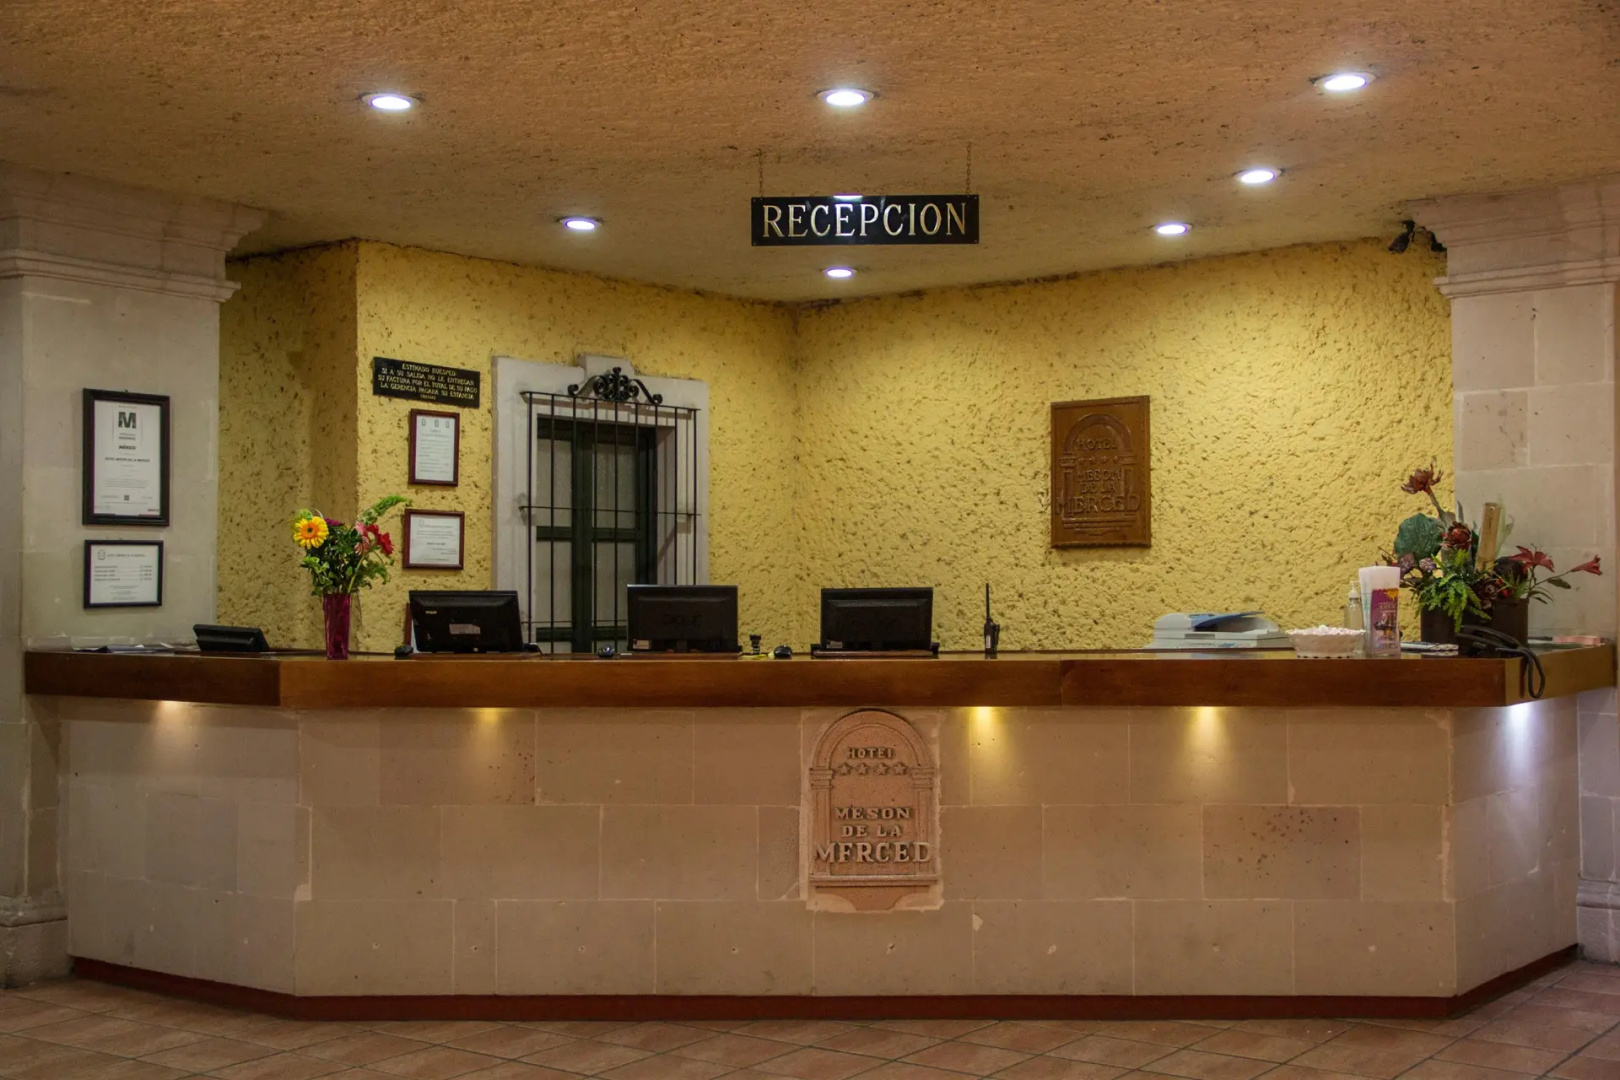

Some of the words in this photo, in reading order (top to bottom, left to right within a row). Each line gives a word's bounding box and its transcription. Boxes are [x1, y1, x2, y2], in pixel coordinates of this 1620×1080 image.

[762, 203, 966, 238] RECEPCION
[402, 363, 430, 373] ESTIMADO
[406, 371, 425, 380] SALIDA
[380, 381, 388, 389] LA
[390, 383, 416, 392] GERENCIA
[449, 390, 475, 399] ESTANCIA
[386, 375, 411, 385] FACTURA
[431, 381, 448, 390] TOTAL
[464, 386, 478, 394] PAGO
[118, 411, 136, 429] M
[1077, 439, 1118, 450] HOTEL
[1080, 482, 1097, 494] DE
[1055, 495, 1142, 514] MERCED
[846, 746, 896, 759] HOTEL
[834, 806, 913, 820] MESON
[841, 824, 868, 837] DE
[876, 824, 903, 837] LA
